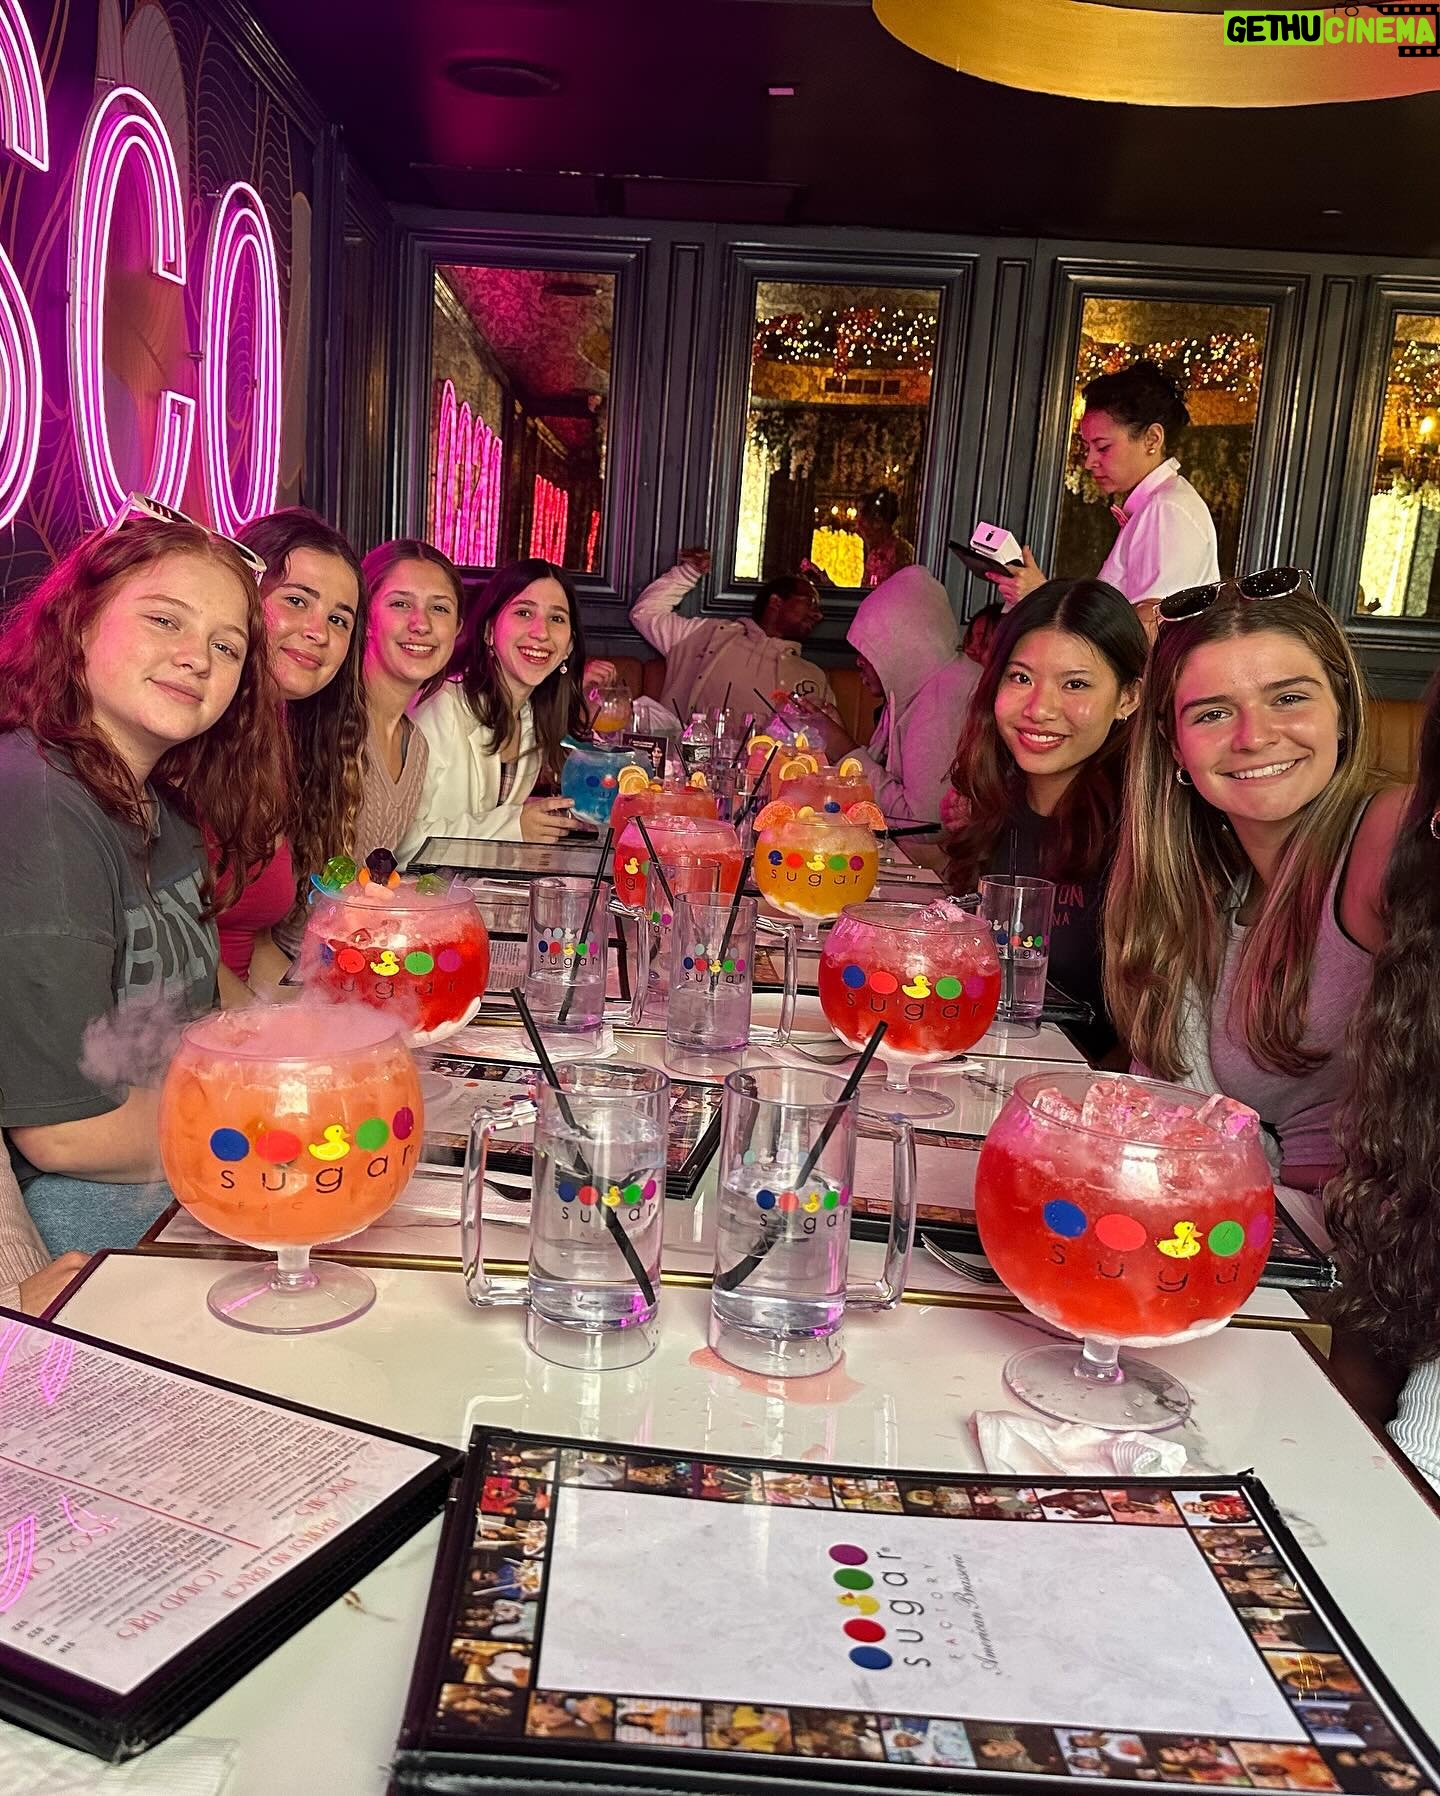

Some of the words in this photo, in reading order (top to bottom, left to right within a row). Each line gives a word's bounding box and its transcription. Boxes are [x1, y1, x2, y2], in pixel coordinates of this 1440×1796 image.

[771, 869, 860, 887] sugar
[539, 954, 598, 969] sugar
[685, 971, 745, 984] suar
[847, 992, 980, 1021] sugar
[220, 1144, 413, 1194] sugar
[561, 1203, 656, 1223] suar
[760, 1208, 849, 1234] sgar
[875, 1548, 932, 1668] sugar
[922, 1563, 964, 1661] FACTORY
[970, 1610, 1003, 1676] American
